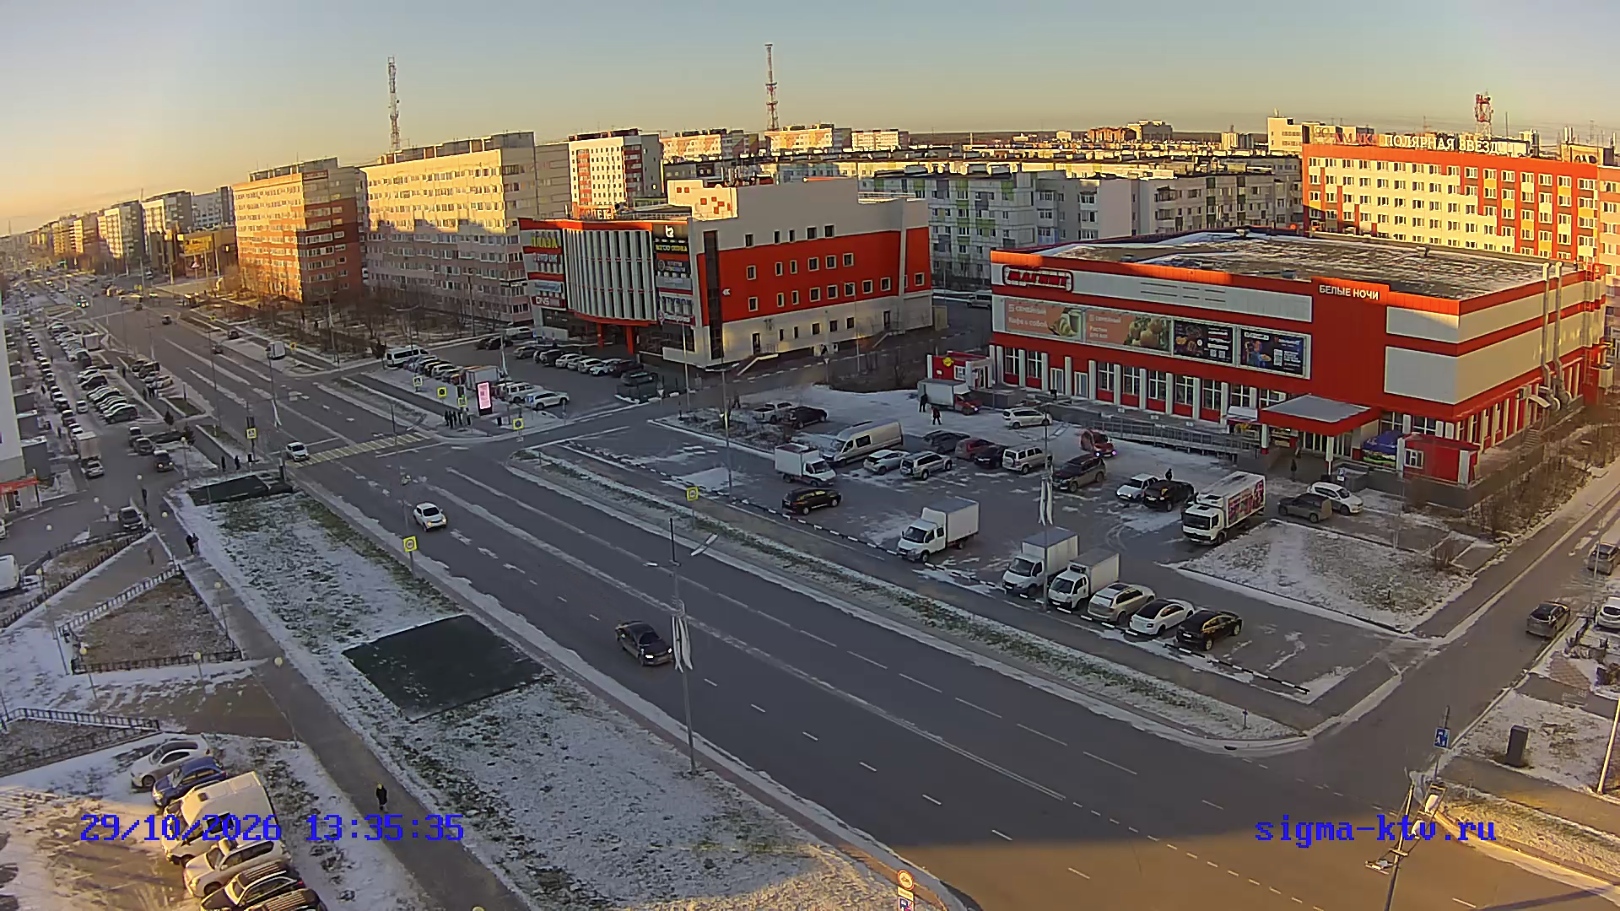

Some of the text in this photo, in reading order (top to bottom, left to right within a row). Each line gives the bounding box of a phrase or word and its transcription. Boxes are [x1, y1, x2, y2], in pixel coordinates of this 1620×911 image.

[1384, 135, 1455, 151] ПОЛЯРНАЯ
[1319, 284, 1379, 300] БЕЛЫЕ НОЧИ
